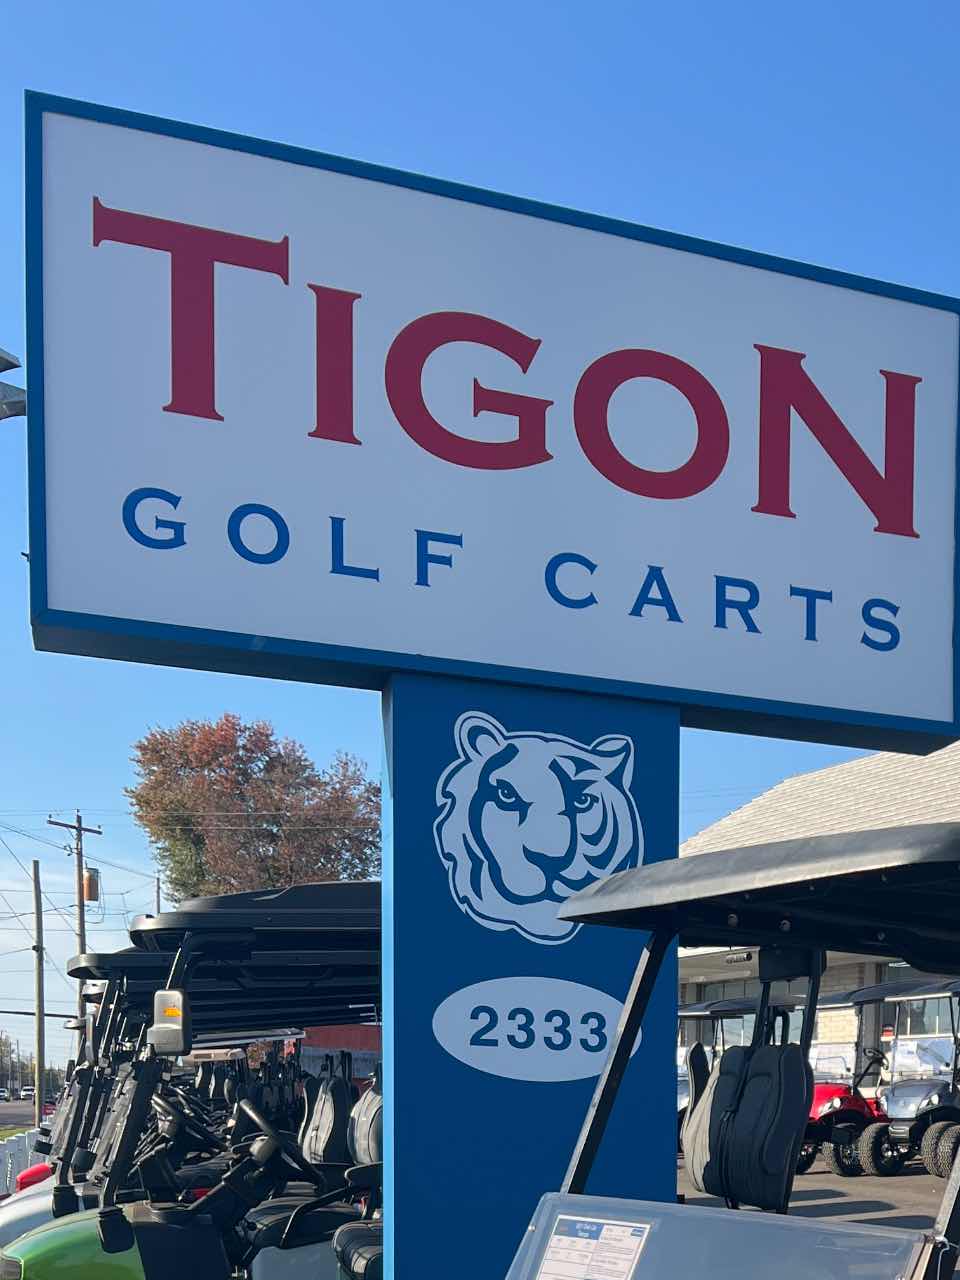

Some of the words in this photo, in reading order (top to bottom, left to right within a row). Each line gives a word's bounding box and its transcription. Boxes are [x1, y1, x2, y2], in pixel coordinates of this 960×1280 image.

[93, 195, 923, 539] TIGON
[121, 486, 464, 588] GOLF
[544, 552, 902, 652] CARTS
[469, 1005, 608, 1053] 2333
